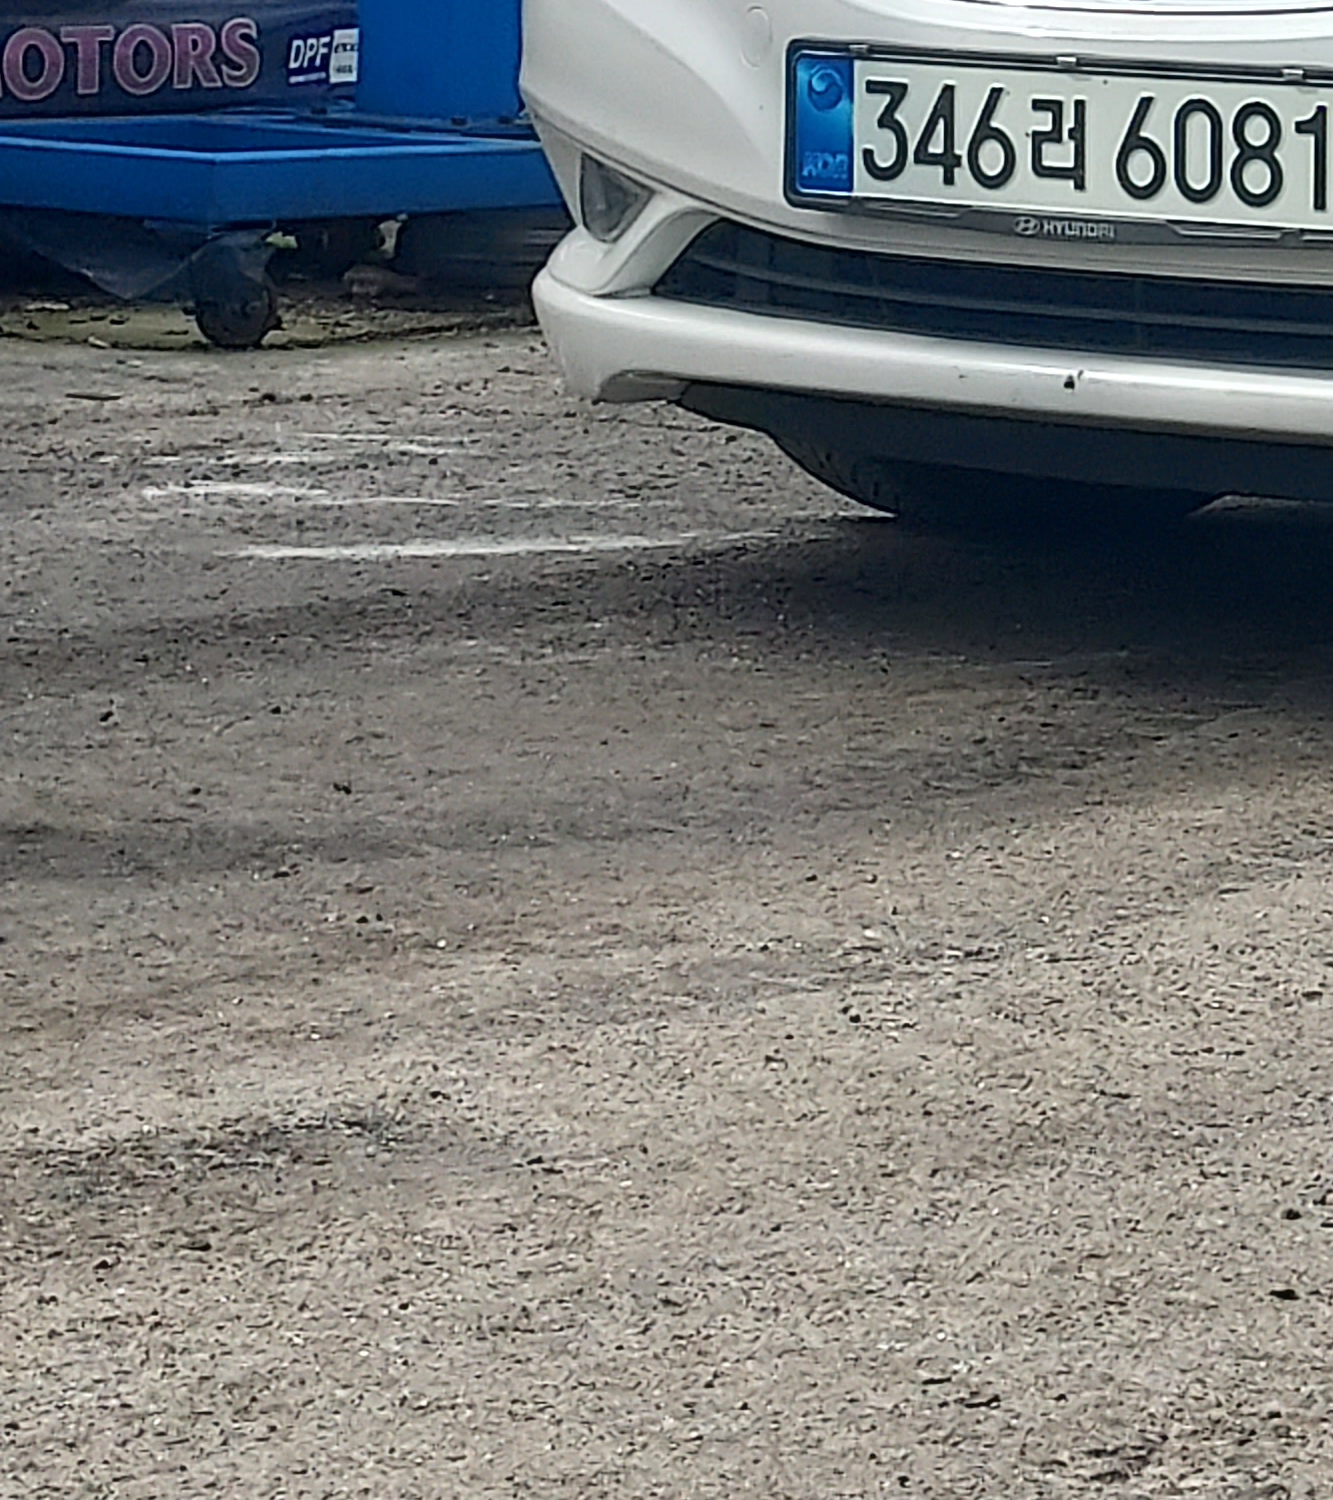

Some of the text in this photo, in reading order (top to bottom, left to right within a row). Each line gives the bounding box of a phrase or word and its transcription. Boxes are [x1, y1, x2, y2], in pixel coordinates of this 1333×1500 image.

[0, 17, 260, 101] OTORS
[288, 35, 331, 69] DPF
[861, 77, 1330, 213] 346러 6081
[1042, 219, 1116, 239] HYUNDAI
